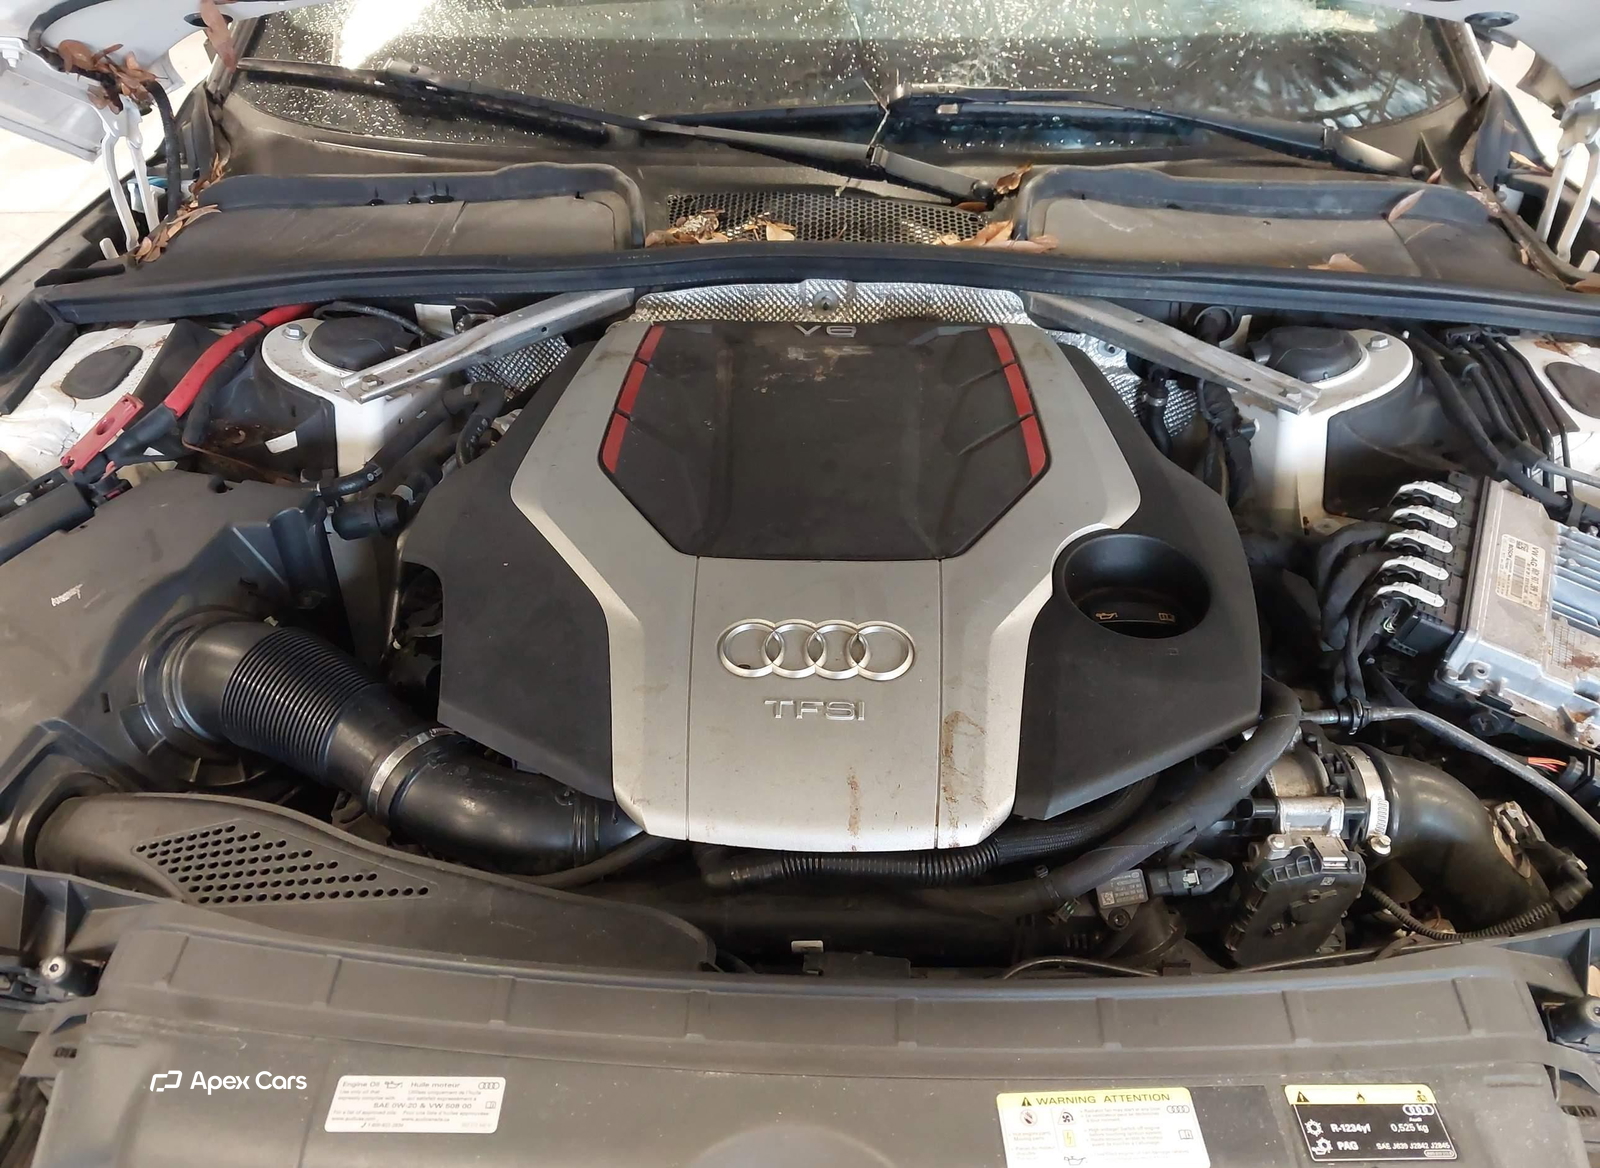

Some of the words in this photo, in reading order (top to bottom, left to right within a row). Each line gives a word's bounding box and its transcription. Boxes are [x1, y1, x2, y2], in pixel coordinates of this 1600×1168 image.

[794, 324, 857, 338] V6
[764, 700, 865, 720] TFSI
[1036, 1096, 1096, 1105] WARNING
[1104, 1093, 1170, 1103] ATTENTION
[1330, 1123, 1371, 1134] R-1234yf
[1390, 1124, 1416, 1133] 0,525
[1416, 1123, 1429, 1134] kg
[1336, 1141, 1359, 1151] PAG
[1376, 1142, 1391, 1150] SAE
